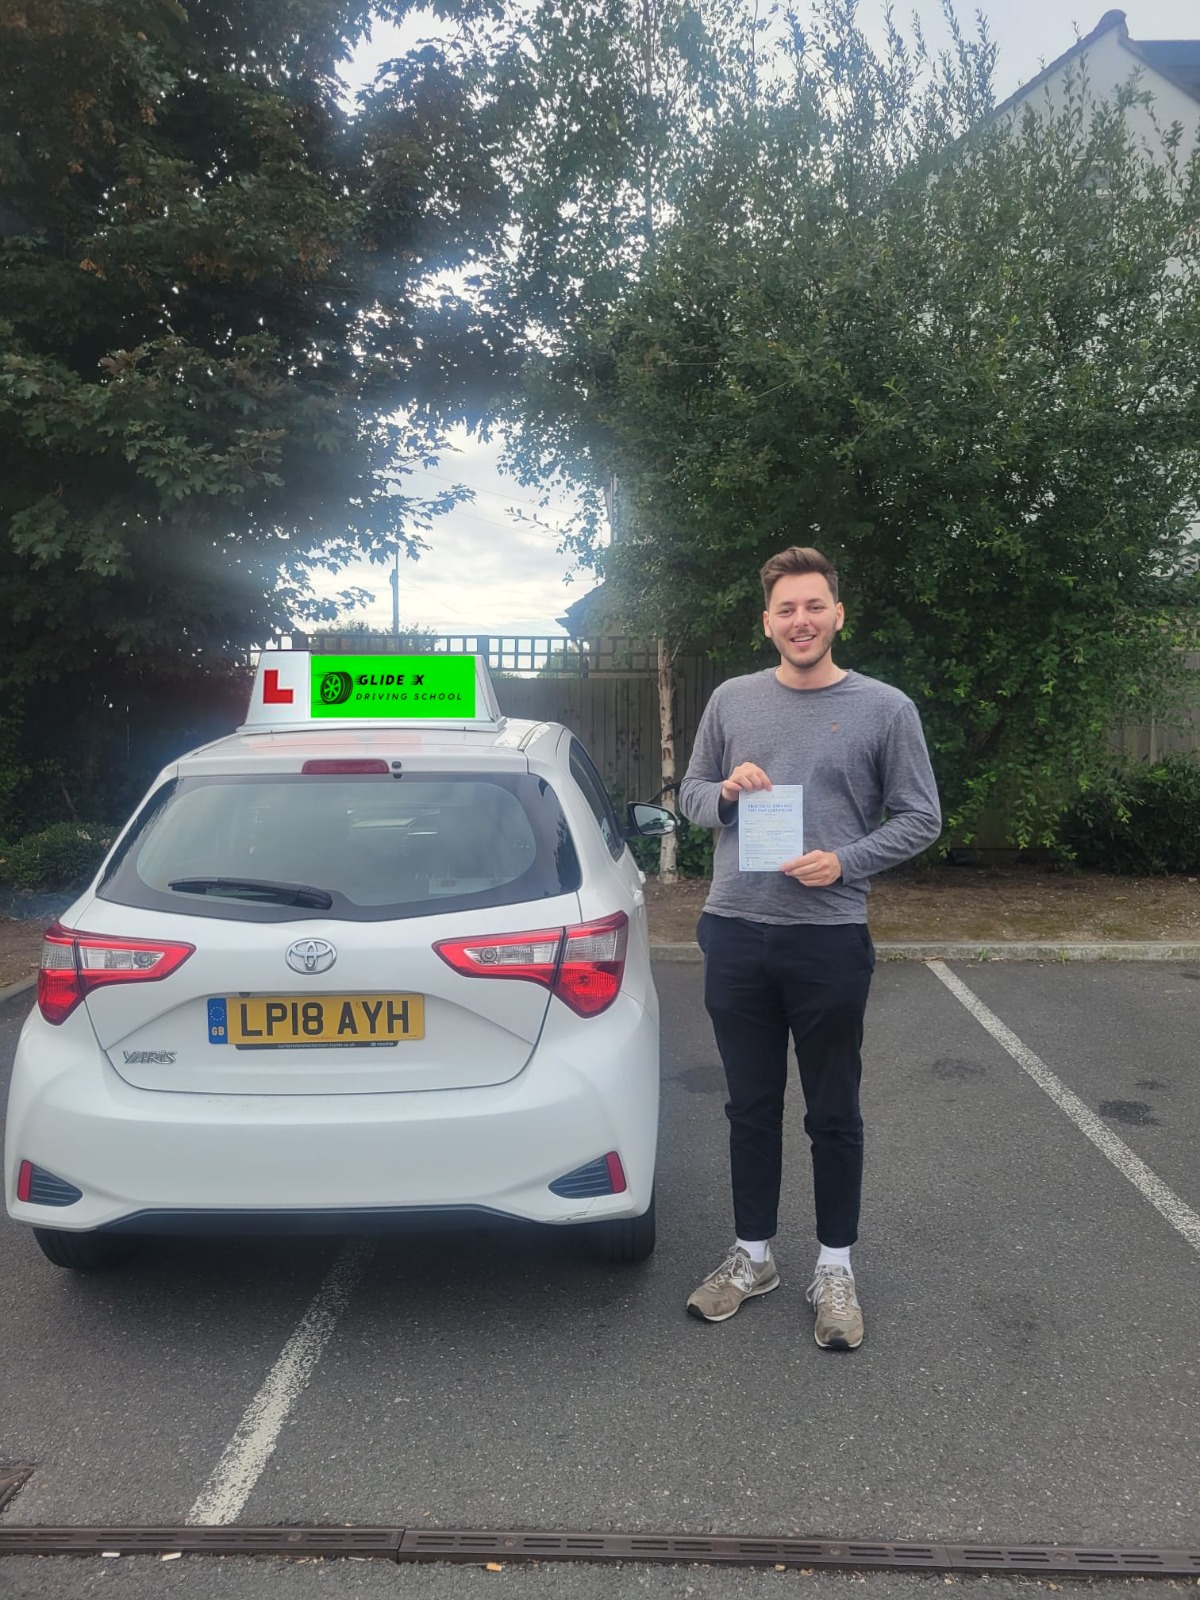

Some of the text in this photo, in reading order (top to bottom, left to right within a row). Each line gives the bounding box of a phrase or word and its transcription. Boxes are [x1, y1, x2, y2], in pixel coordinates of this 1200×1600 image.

[357, 674, 425, 686] GLIDE X
[263, 669, 293, 704] L
[355, 693, 462, 701] DRIVING SCHOOL
[240, 1000, 409, 1037] LP18 AYH
[211, 1026, 225, 1036] GB
